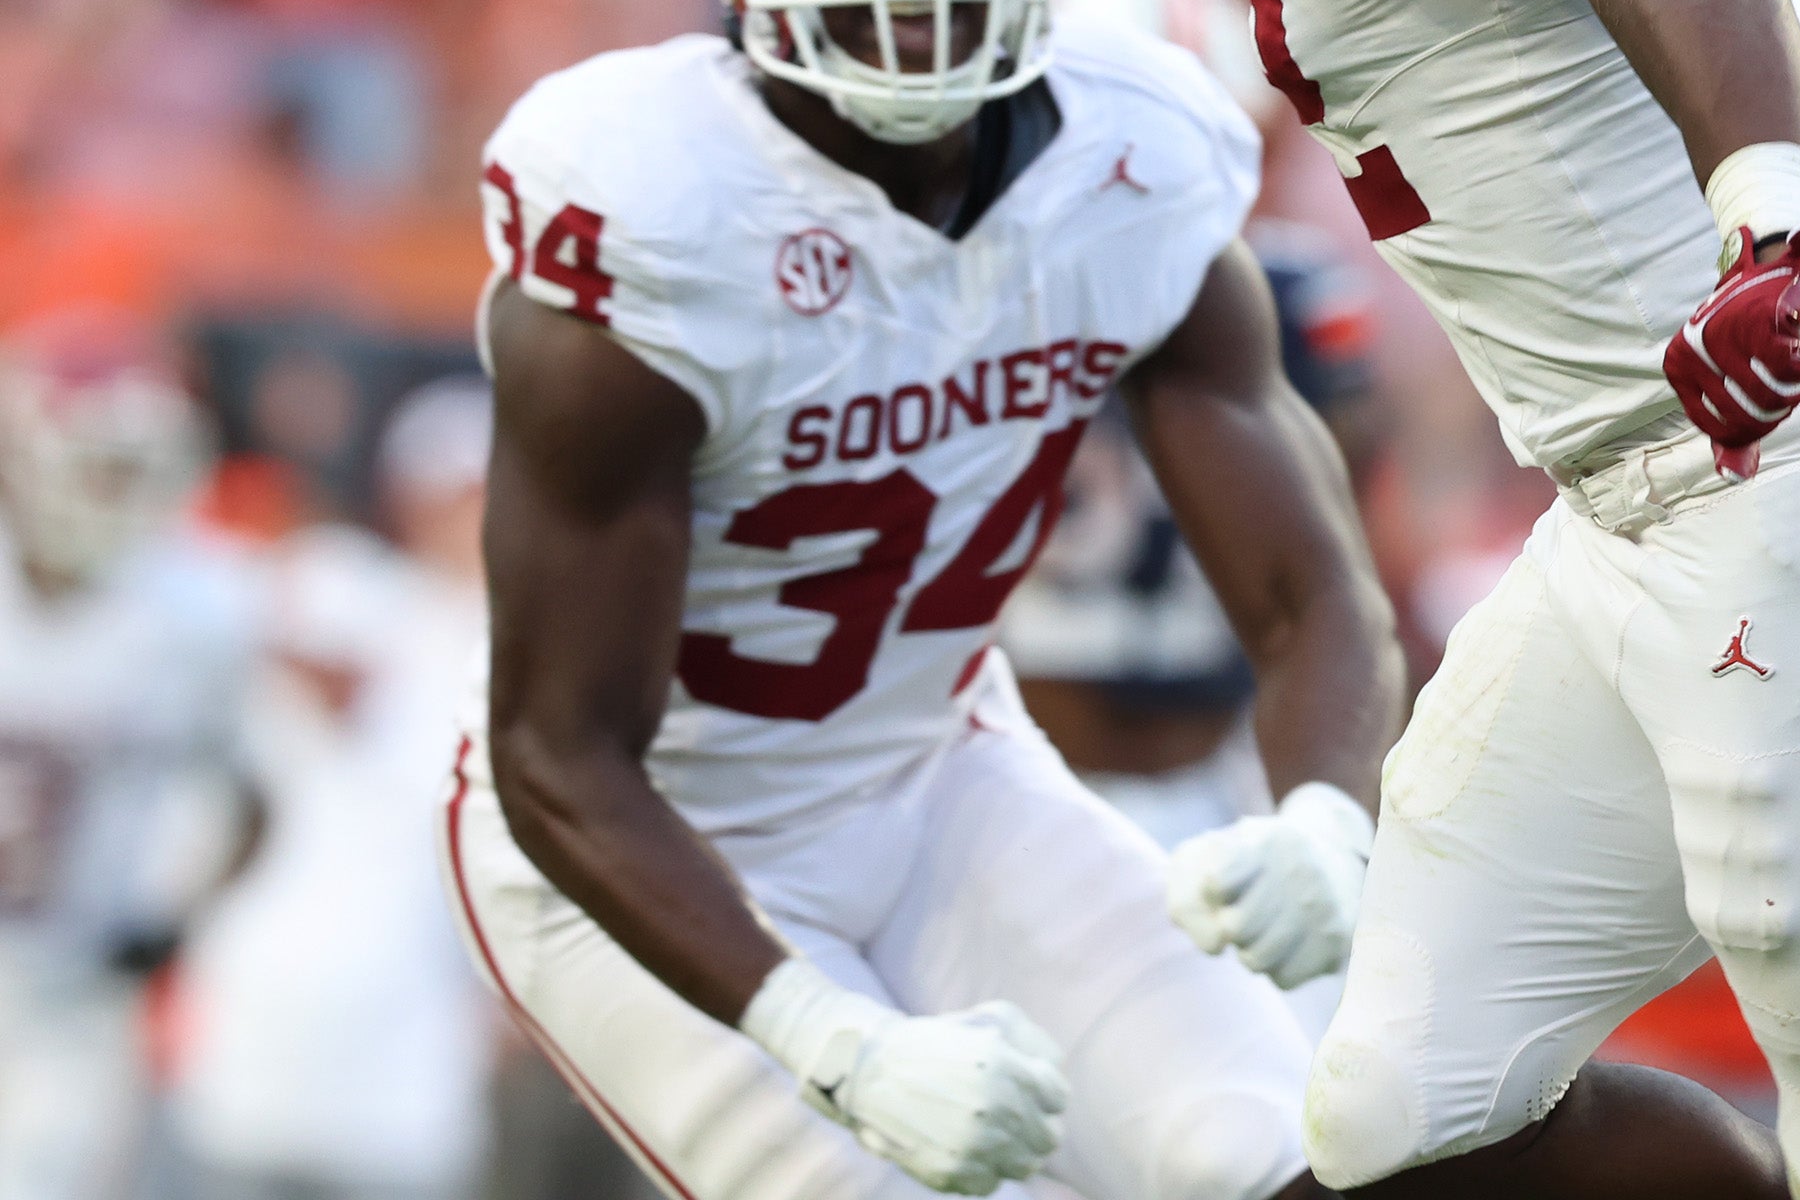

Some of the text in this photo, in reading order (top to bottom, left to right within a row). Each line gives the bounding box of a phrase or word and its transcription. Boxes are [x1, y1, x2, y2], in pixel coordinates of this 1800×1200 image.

[775, 228, 852, 316] SEC
[782, 340, 1128, 471] SOONERS
[675, 418, 1089, 721] 34
